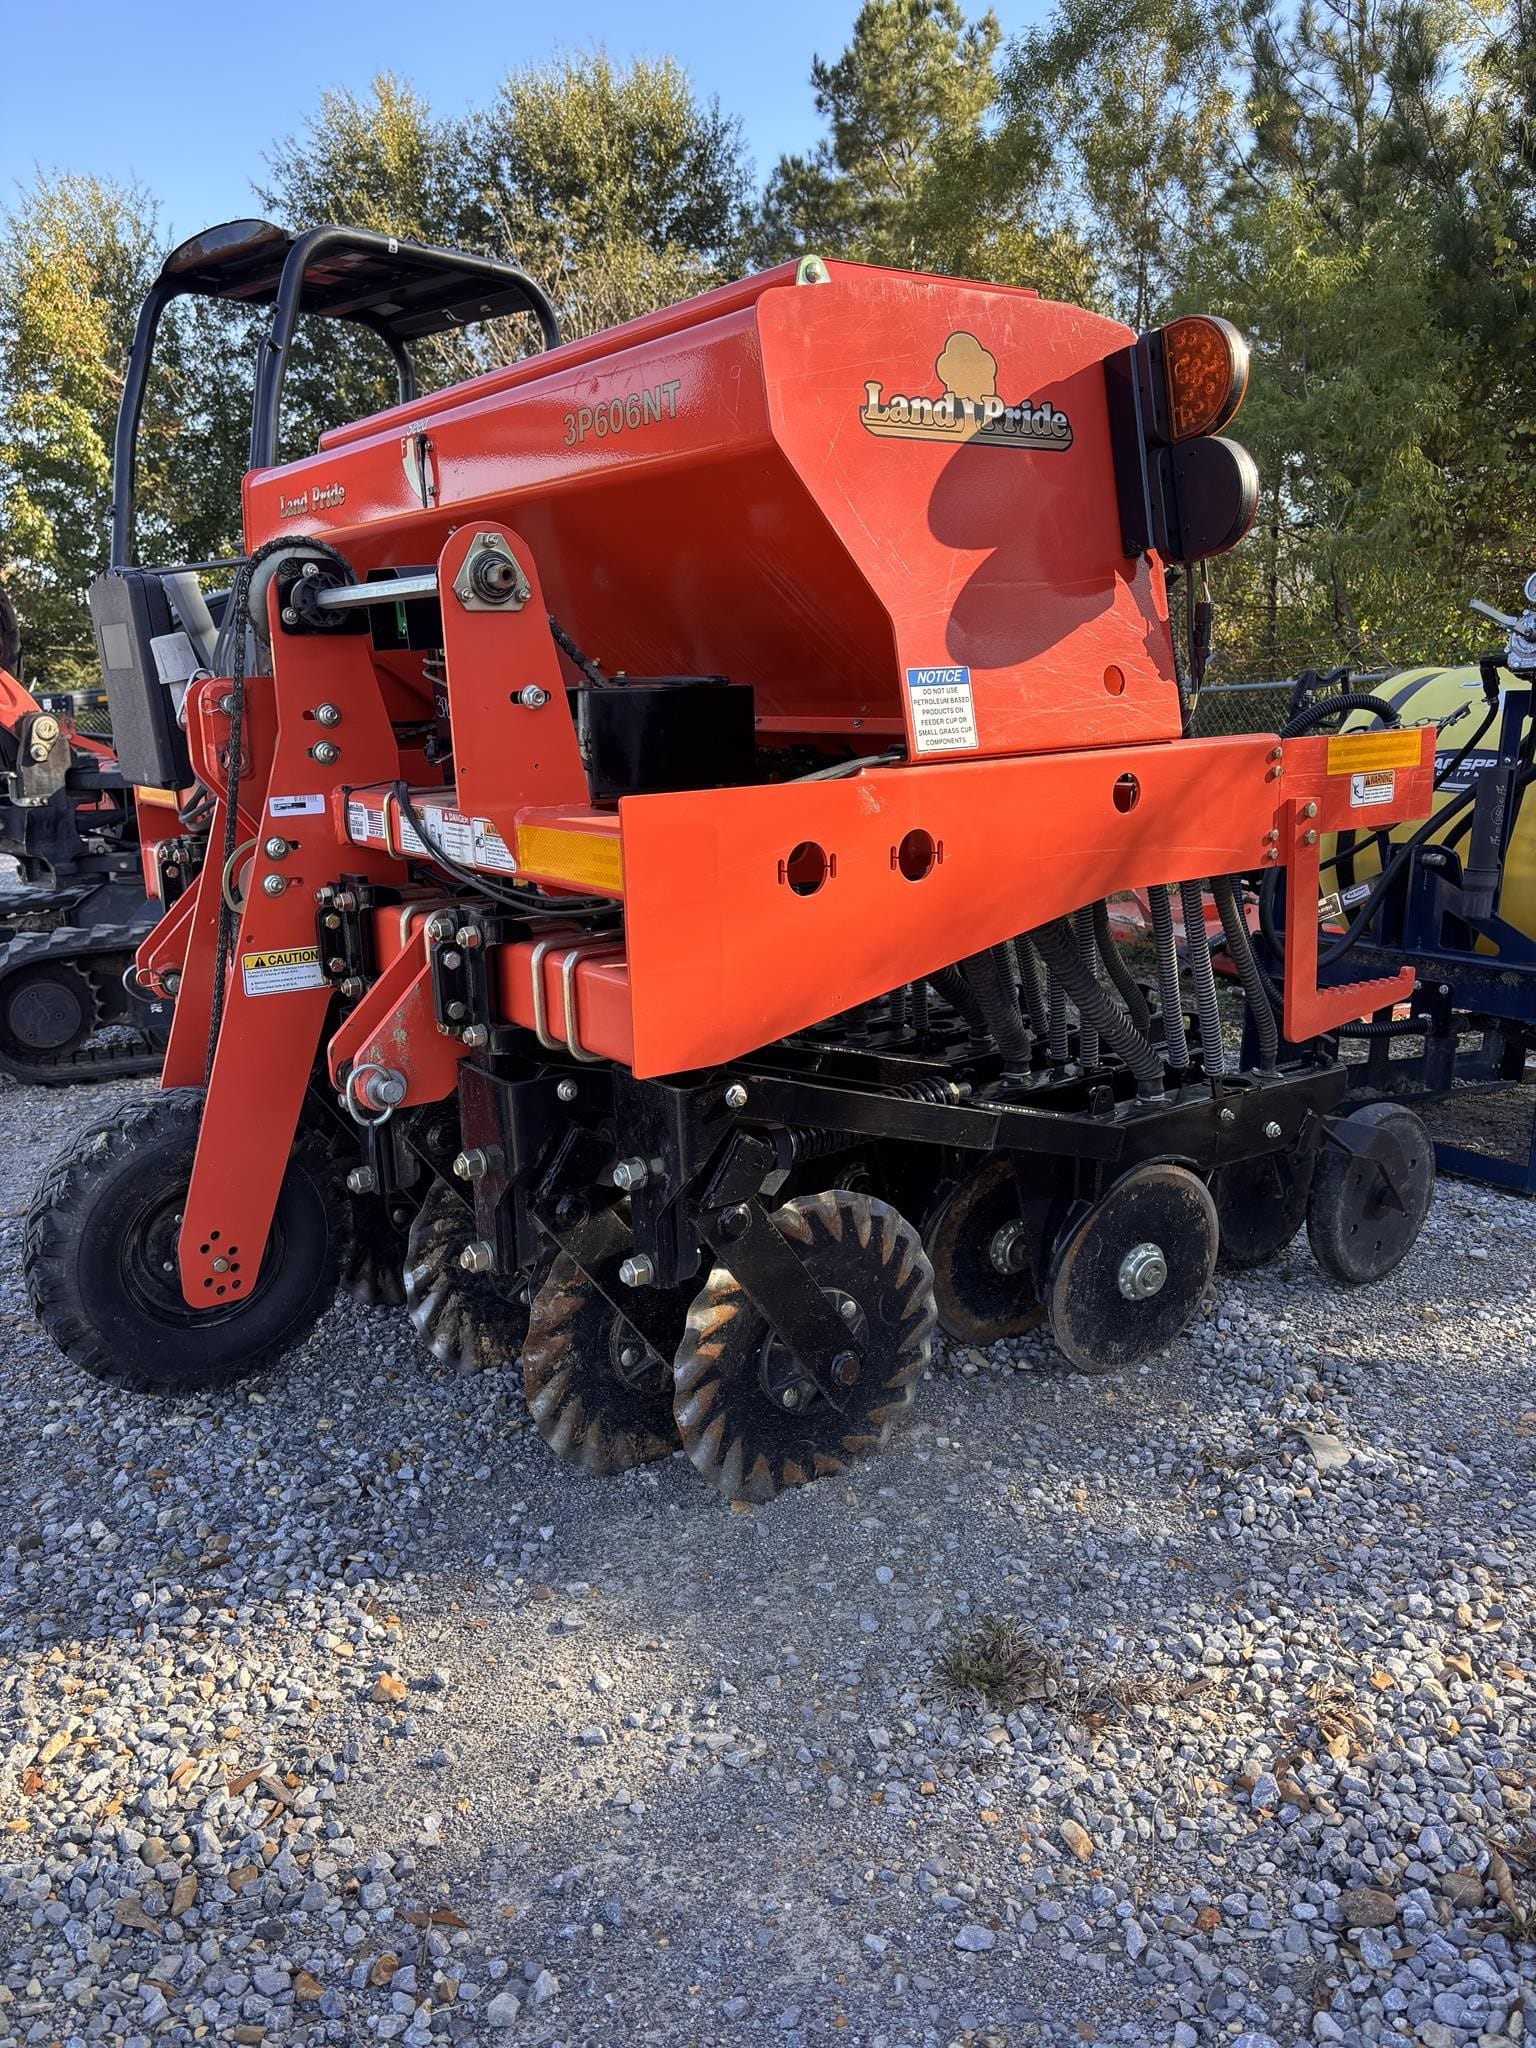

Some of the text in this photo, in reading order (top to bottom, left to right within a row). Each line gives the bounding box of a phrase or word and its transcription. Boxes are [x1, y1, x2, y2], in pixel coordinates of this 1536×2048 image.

[563, 378, 681, 446] 3P606NT
[864, 381, 1068, 437] Land Pride
[280, 481, 345, 518] Land Pride
[917, 669, 962, 684] NOTICE
[913, 697, 949, 706] PETROLEUM
[921, 718, 944, 726] FEEDER
[1370, 773, 1393, 785] WARNING
[268, 951, 319, 966] CAUTION
